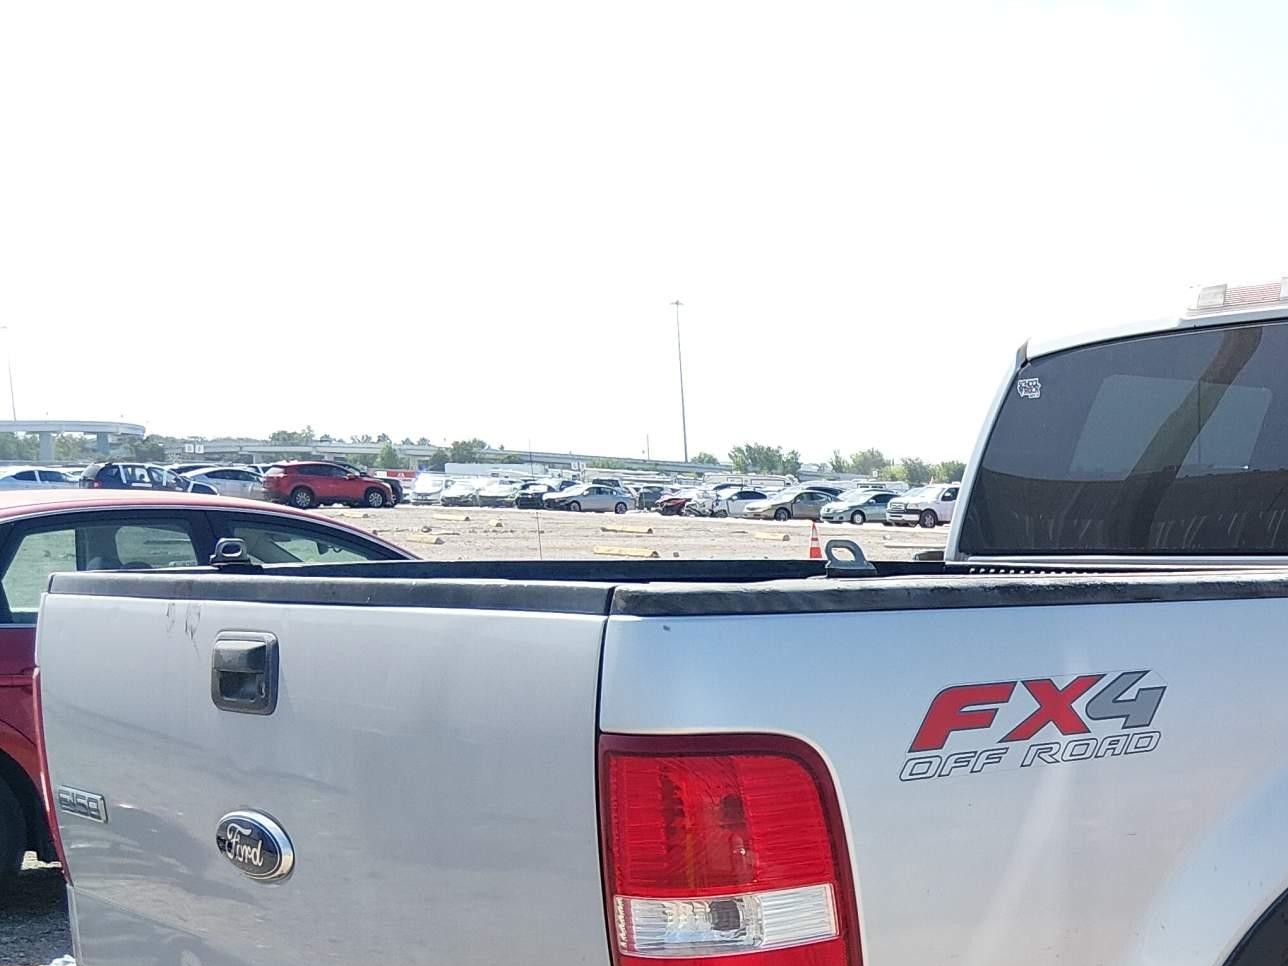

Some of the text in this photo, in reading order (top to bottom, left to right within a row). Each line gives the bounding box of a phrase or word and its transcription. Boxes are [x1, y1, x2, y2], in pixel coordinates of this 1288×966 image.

[908, 669, 1167, 753] FX4
[899, 730, 1162, 782] OFF ROAD
[225, 822, 264, 867] Ford
